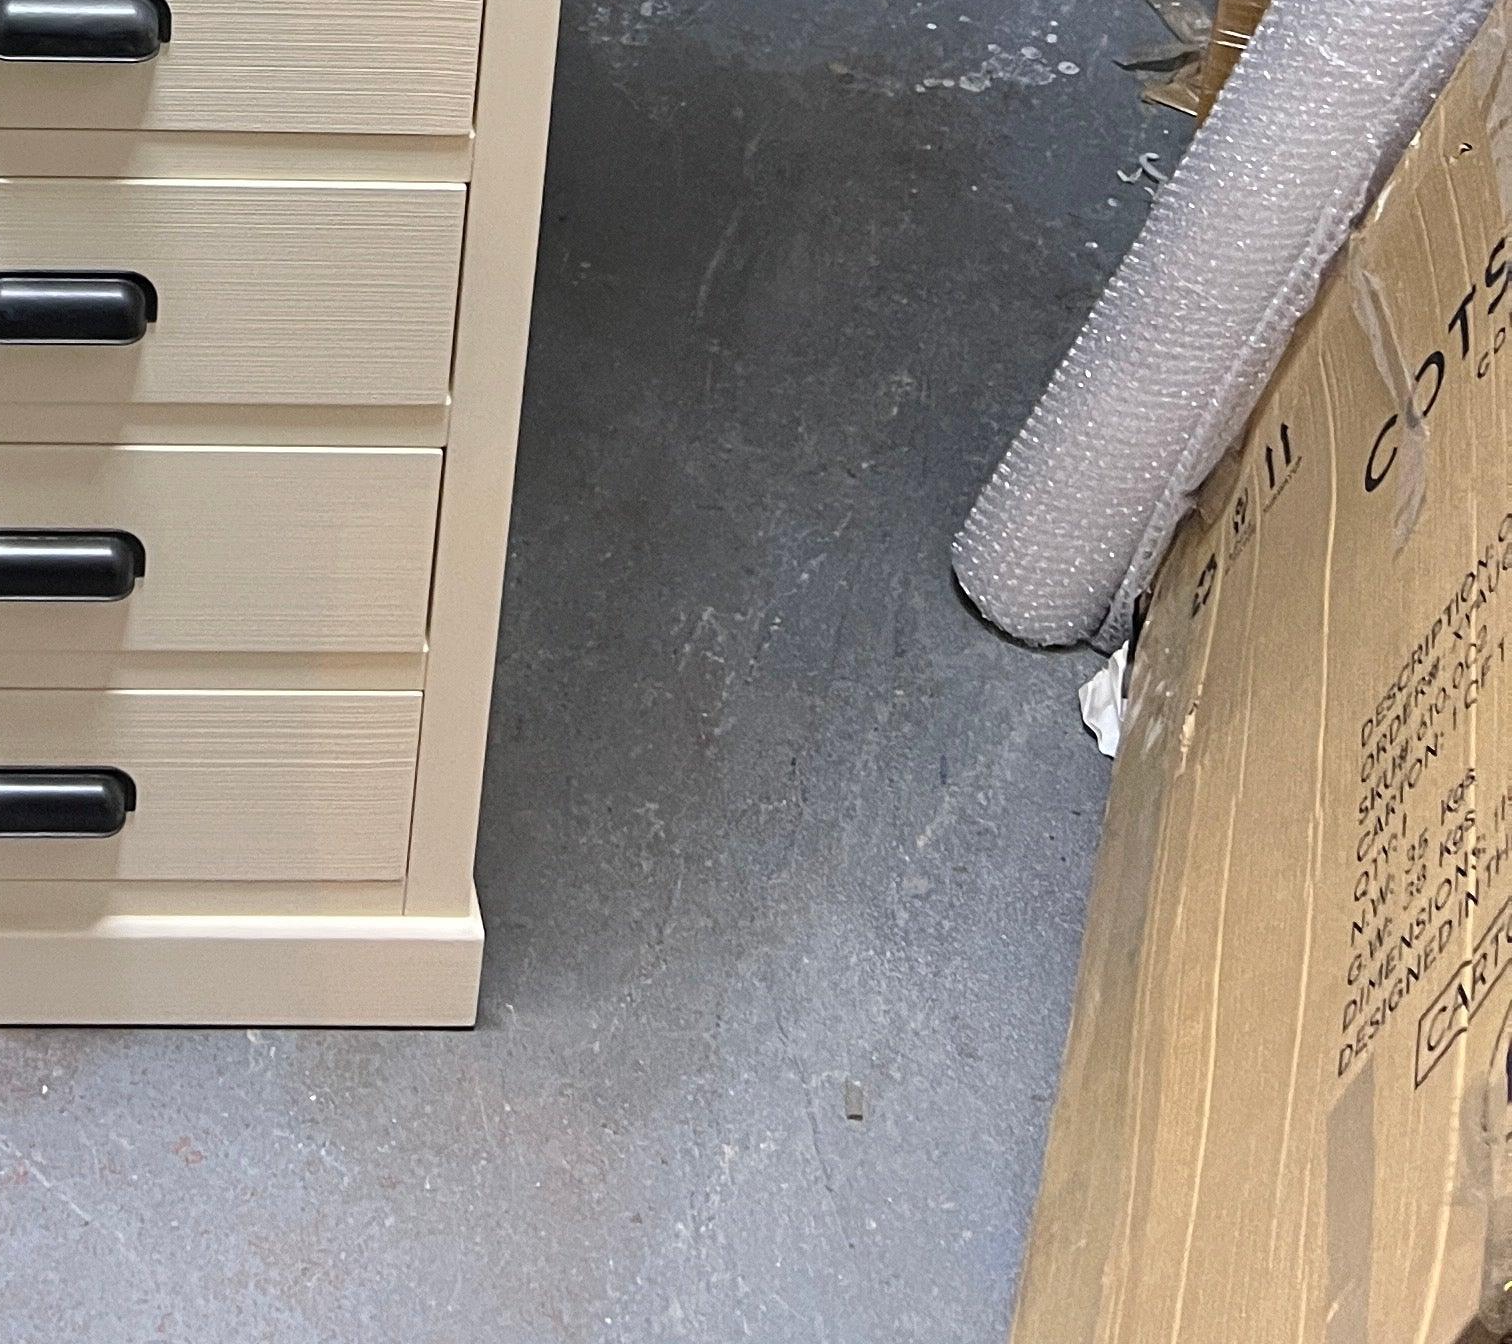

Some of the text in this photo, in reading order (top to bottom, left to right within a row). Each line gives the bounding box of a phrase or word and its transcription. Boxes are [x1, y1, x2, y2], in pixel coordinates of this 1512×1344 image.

[1361, 543, 1494, 748] DESCRIPTION:
[1356, 731, 1444, 862] CARTON:
[1338, 919, 1453, 1078] DESIGNED
[1457, 877, 1480, 928] IN
